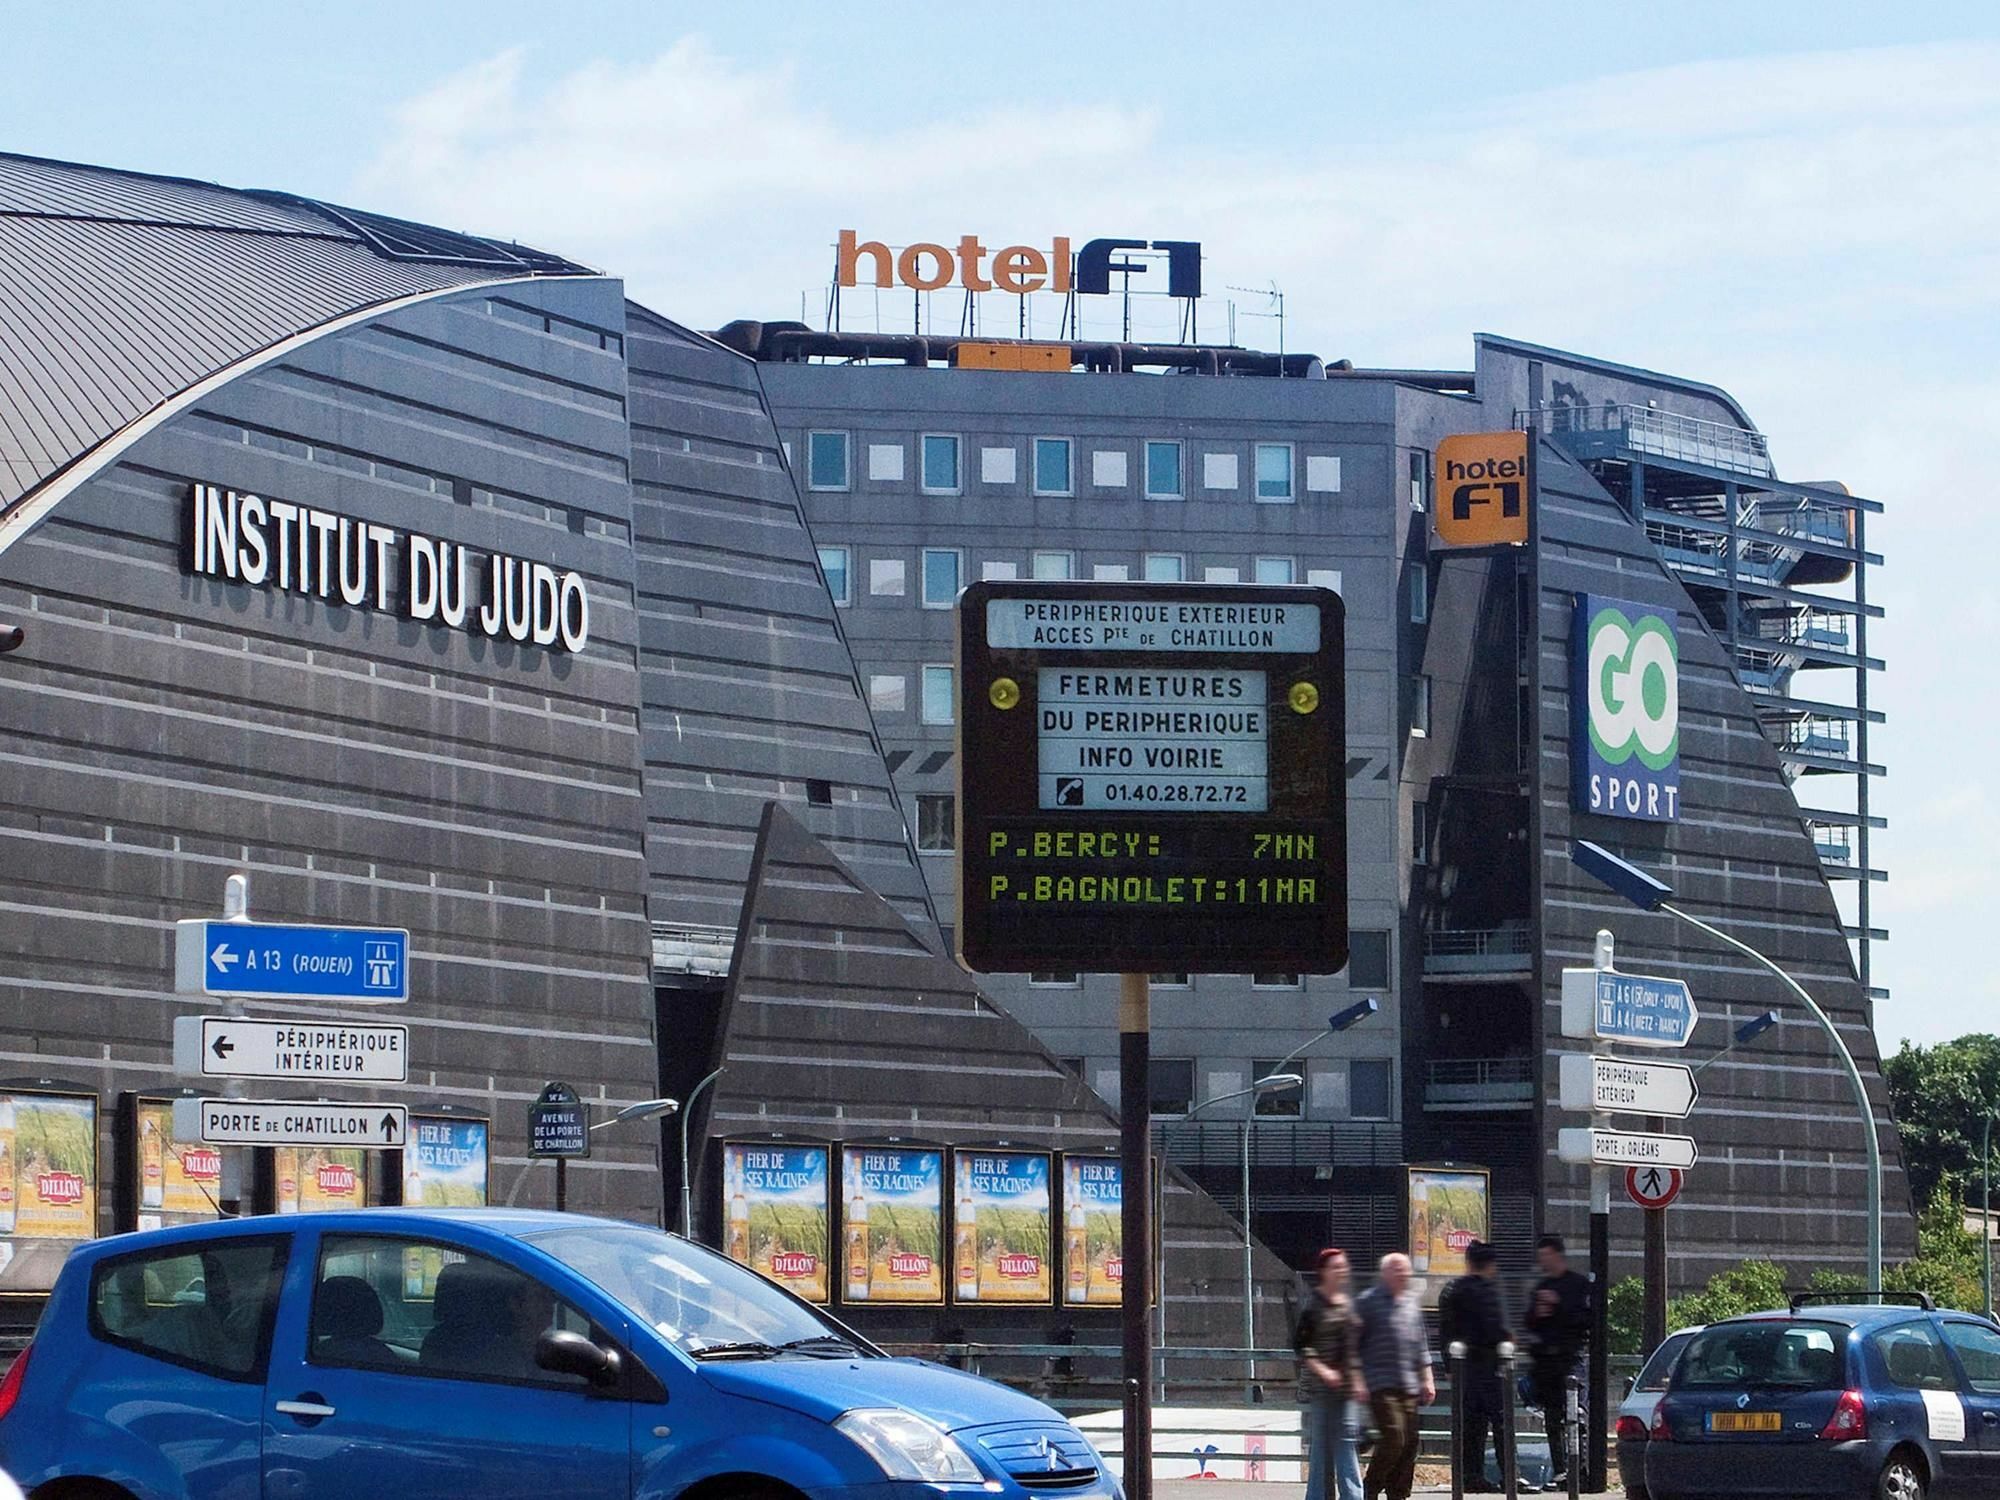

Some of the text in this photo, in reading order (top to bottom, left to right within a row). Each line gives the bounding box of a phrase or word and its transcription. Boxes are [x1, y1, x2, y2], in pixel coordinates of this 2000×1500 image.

[838, 229, 1202, 298] hotel F1
[1446, 454, 1526, 481] hotel
[1452, 482, 1521, 520] F1
[193, 483, 590, 653] INSTITUT DU JUDO
[1024, 604, 1286, 625] PERIPHERIQUE EXTERIEUR
[1033, 627, 1094, 644] ACCES
[1140, 633, 1155, 645] DE
[1171, 629, 1274, 647] CHATILLON
[1059, 675, 1243, 698] FERMETURES
[1588, 622, 1679, 756] GO
[1043, 711, 1260, 734] DU PERIPHERIQUE
[1079, 747, 1224, 769] INFO VOIRIE
[1105, 785, 1247, 802] 01.40.28.72.72
[1590, 774, 1679, 819] SPORT
[989, 832, 1161, 857] P.BERCY:
[246, 949, 353, 977] A 13 (ROUEN)
[1617, 984, 1623, 1004] A
[1617, 1009, 1622, 1029] A
[276, 1028, 399, 1051] PÉRIPHÉRIQUE
[275, 1051, 365, 1072] INTÉRIEUR
[210, 1114, 368, 1134] PORTE DE CHATILLON
[541, 1113, 576, 1123] AVENUE
[534, 1126, 583, 1137] DE LA PORTE
[534, 1140, 544, 1149] DE
[1596, 1138, 1618, 1154] PORTE
[185, 1156, 221, 1172] DILLON
[747, 1153, 784, 1169] FIER DE
[864, 1155, 901, 1172] FIER DE
[974, 1159, 1009, 1174] FIER DE
[319, 1171, 353, 1188] DILLON
[746, 1172, 809, 1189] SES RACINES
[864, 1173, 925, 1191] SES RACINES
[1083, 1165, 1116, 1181] FIER DE
[41, 1179, 81, 1196] DILLON
[973, 1177, 1033, 1194] SES RACINES
[1083, 1183, 1098, 1198] SES
[775, 1257, 814, 1271] DILLON
[892, 1258, 928, 1271] DILLON
[1001, 1260, 1037, 1273] DILLON
